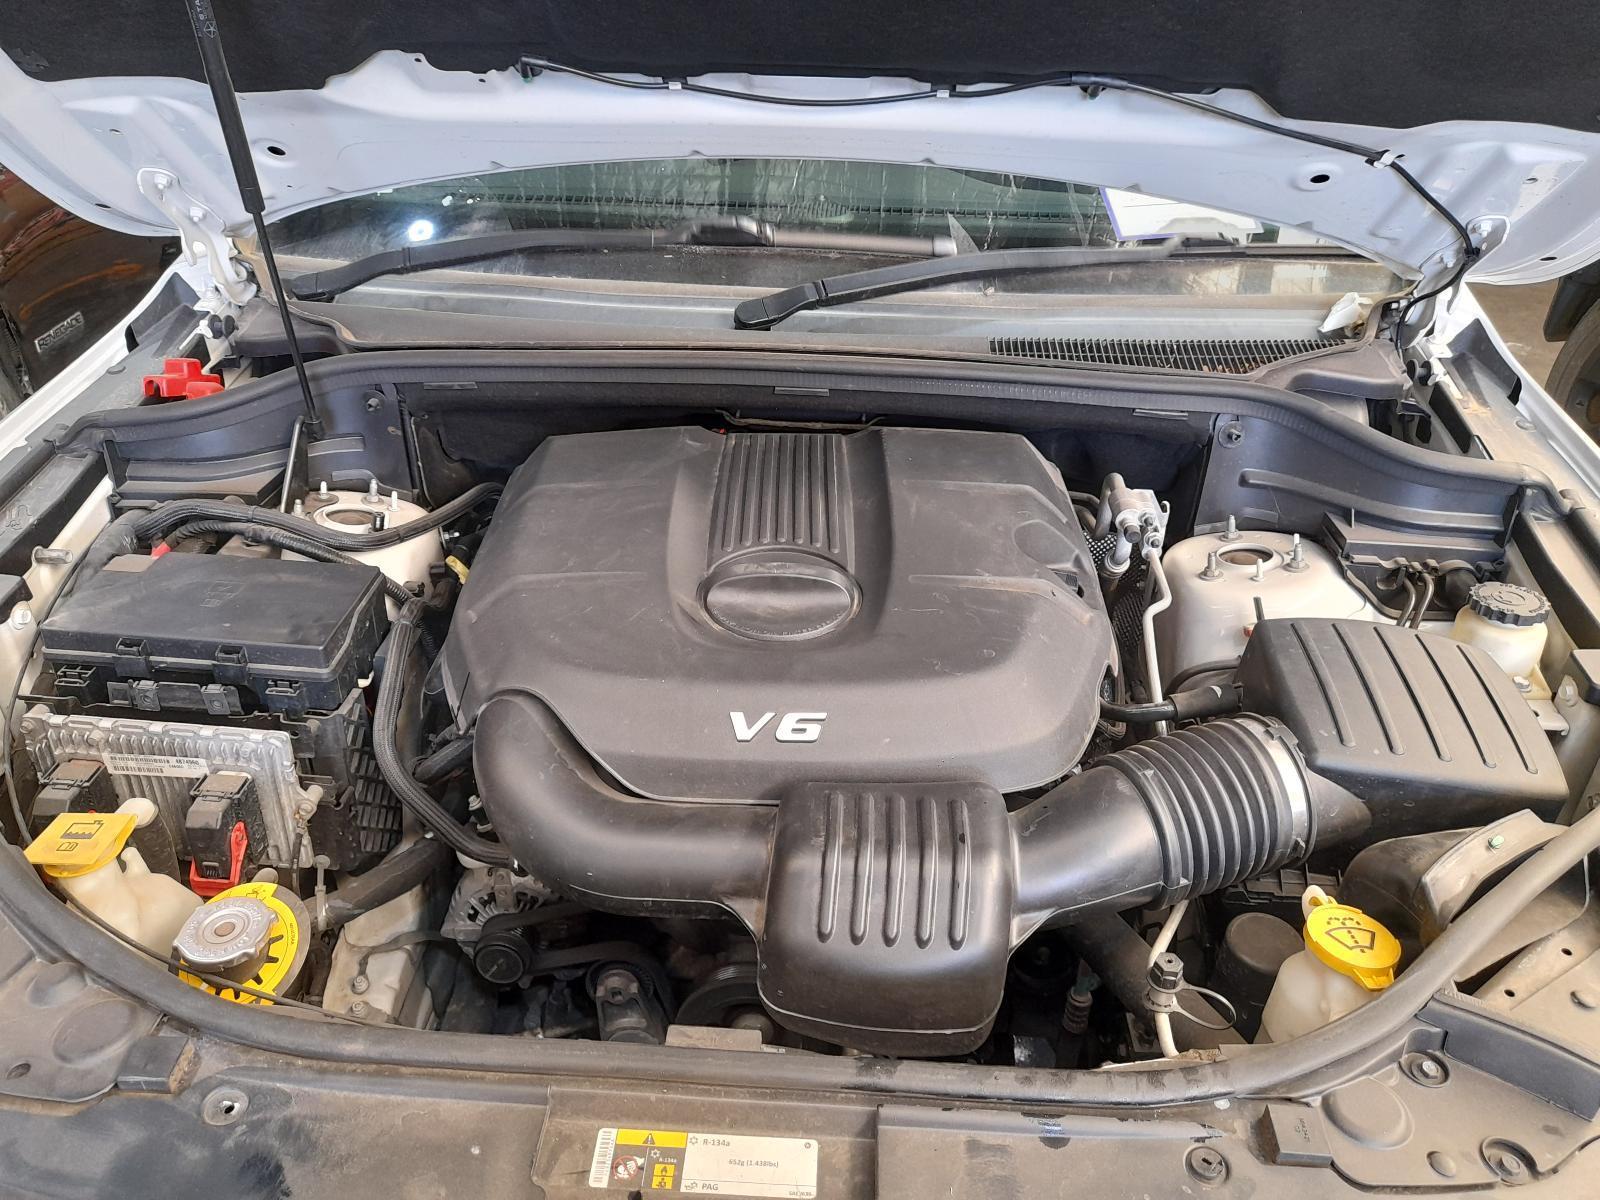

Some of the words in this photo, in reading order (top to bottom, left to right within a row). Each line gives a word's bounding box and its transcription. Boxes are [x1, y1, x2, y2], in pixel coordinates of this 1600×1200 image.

[38, 314, 83, 350] RENEGADE
[729, 711, 828, 743] V6
[702, 1138, 731, 1148] R-134a
[701, 1183, 719, 1192] PAG
